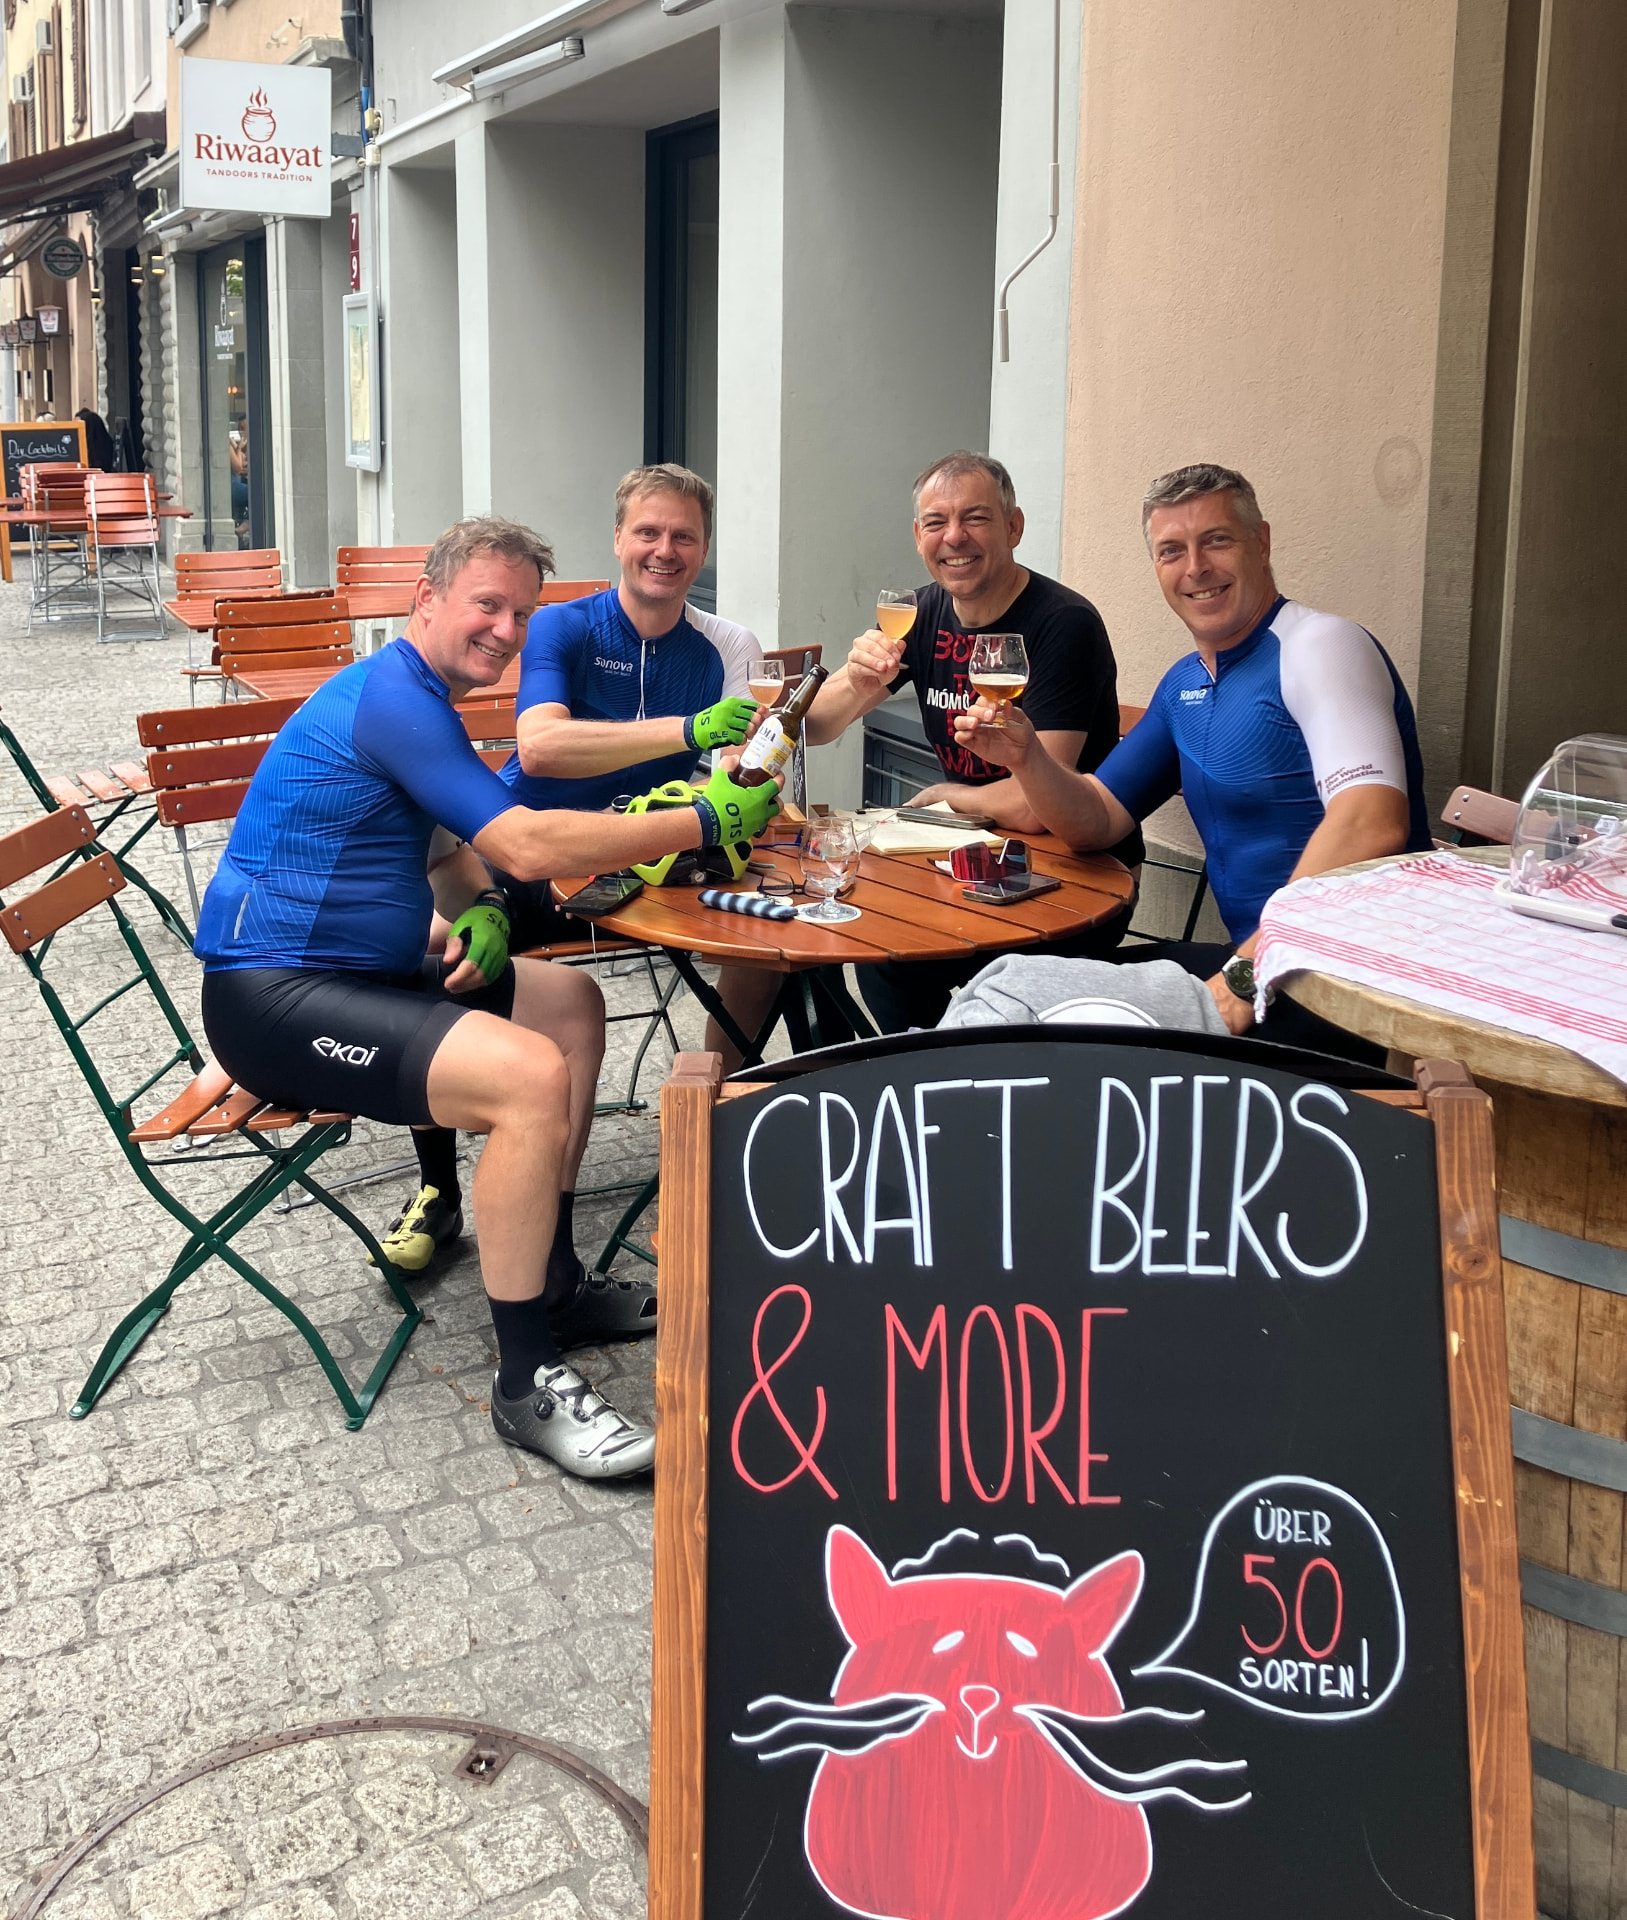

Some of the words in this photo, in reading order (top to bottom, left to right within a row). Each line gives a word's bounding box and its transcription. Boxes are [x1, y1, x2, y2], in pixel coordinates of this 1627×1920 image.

[194, 132, 323, 172] Riwaayat
[206, 168, 259, 179] TANDOORS
[261, 171, 313, 182] TRADITION
[351, 217, 357, 240] 7
[352, 255, 358, 279] 9
[1327, 769, 1384, 795] Foundation
[1340, 763, 1373, 778] World
[725, 802, 743, 839] SLO
[743, 1077, 1051, 1271] CRAFT
[1090, 1075, 1369, 1280] BEERS
[729, 1284, 839, 1505] &
[883, 1302, 1129, 1507] MORE
[1253, 1499, 1334, 1548] ÜBER
[1239, 1553, 1346, 1661] 50
[1238, 1637, 1371, 1702] SORTEN!
